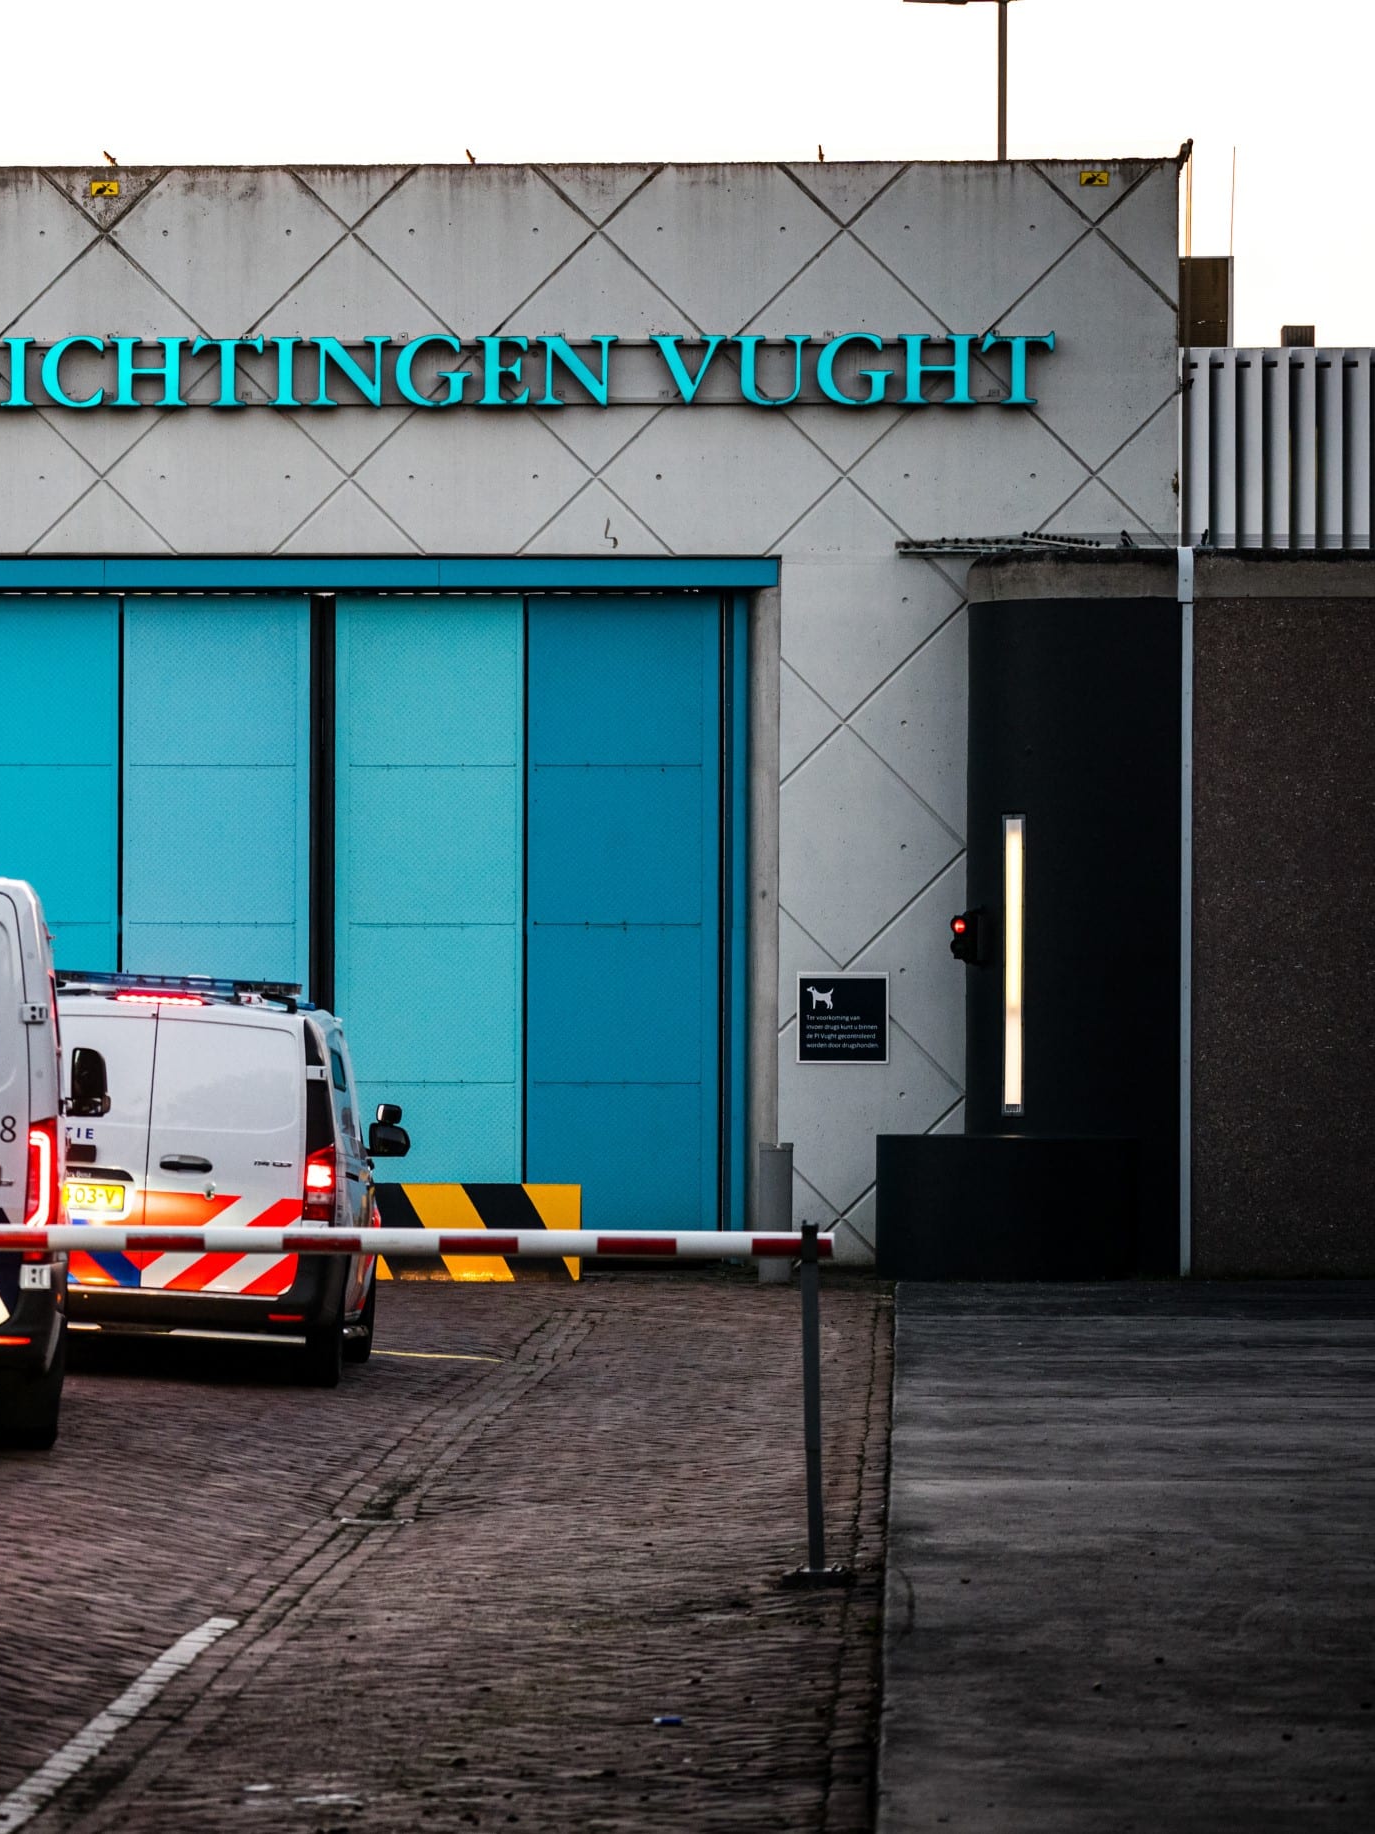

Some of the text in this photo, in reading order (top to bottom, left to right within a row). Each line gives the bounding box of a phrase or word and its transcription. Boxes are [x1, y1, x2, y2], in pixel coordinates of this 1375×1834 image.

[650, 330, 1056, 408] VUGHT
[816, 1014, 850, 1022] voorkoming
[824, 1023, 840, 1031] drugs
[0, 1114, 17, 1143] 8
[66, 1126, 94, 1140] TIE
